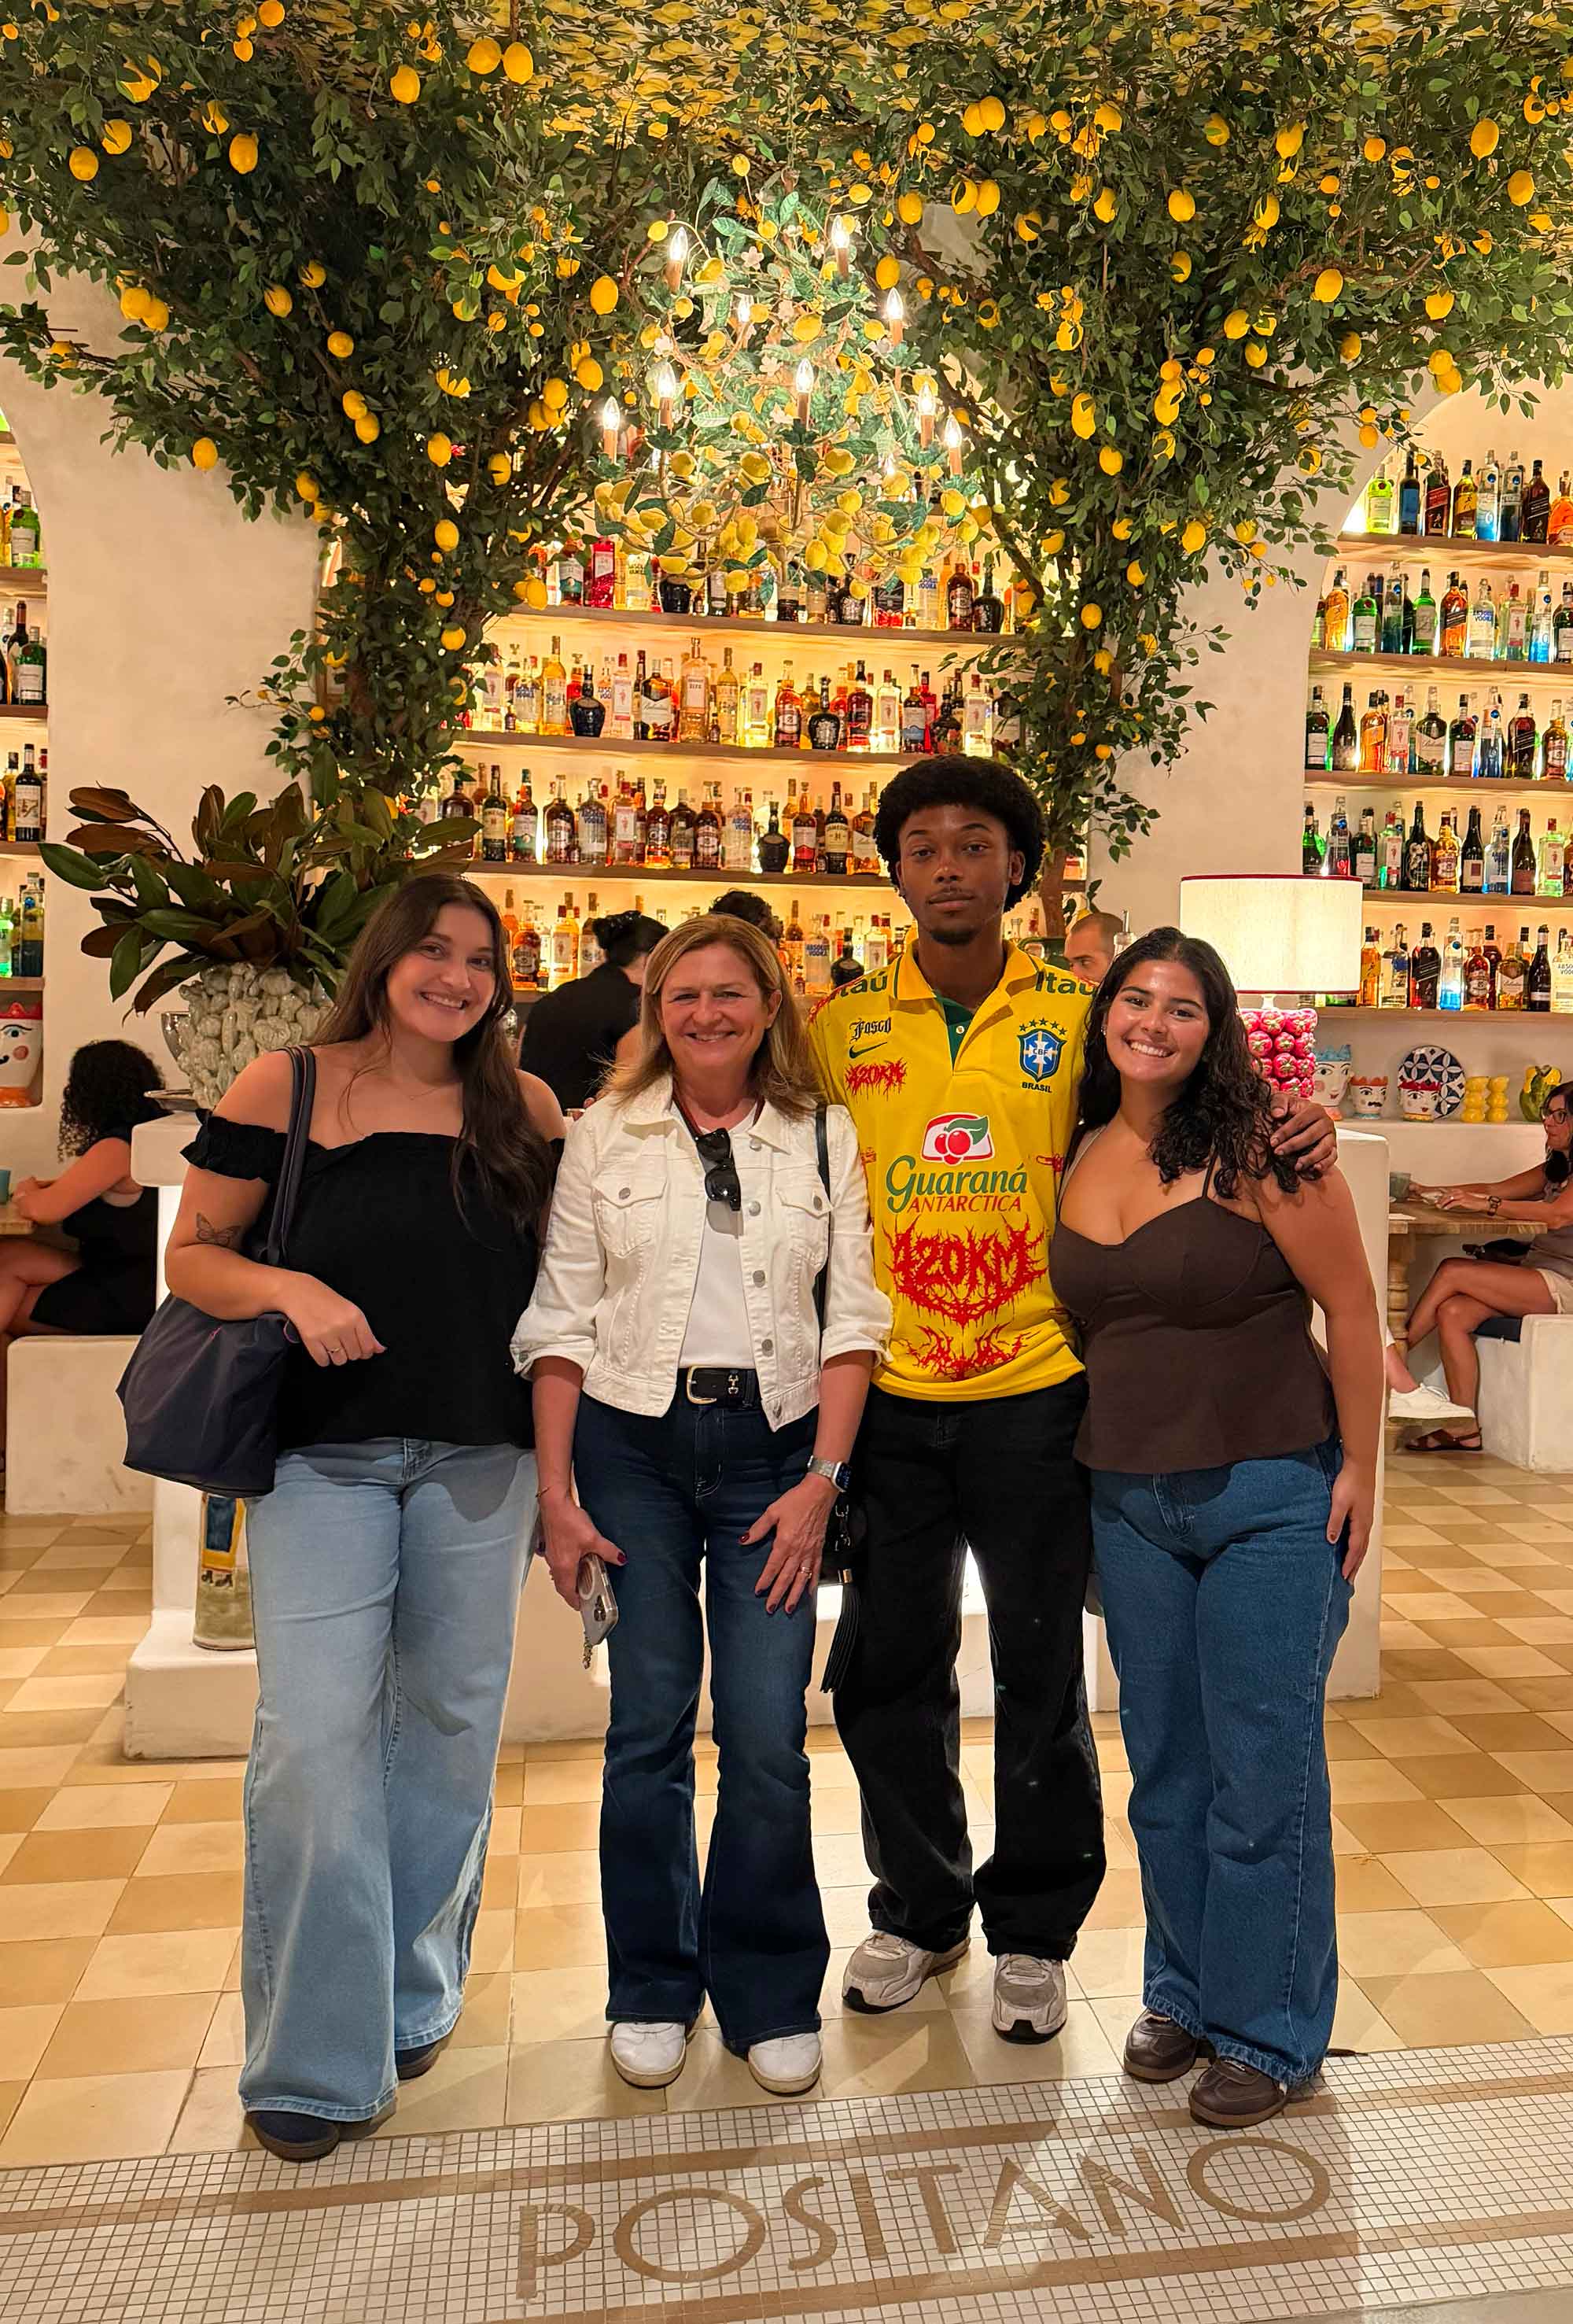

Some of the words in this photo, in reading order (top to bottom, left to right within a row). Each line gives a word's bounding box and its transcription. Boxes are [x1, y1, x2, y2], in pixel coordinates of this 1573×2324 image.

[1022, 1082, 1052, 1094] BRASIL
[886, 1154, 1028, 1213] Guaraná
[906, 1195, 1021, 1213] ANTARCTICA
[516, 2136, 1330, 2300] POSITANO
